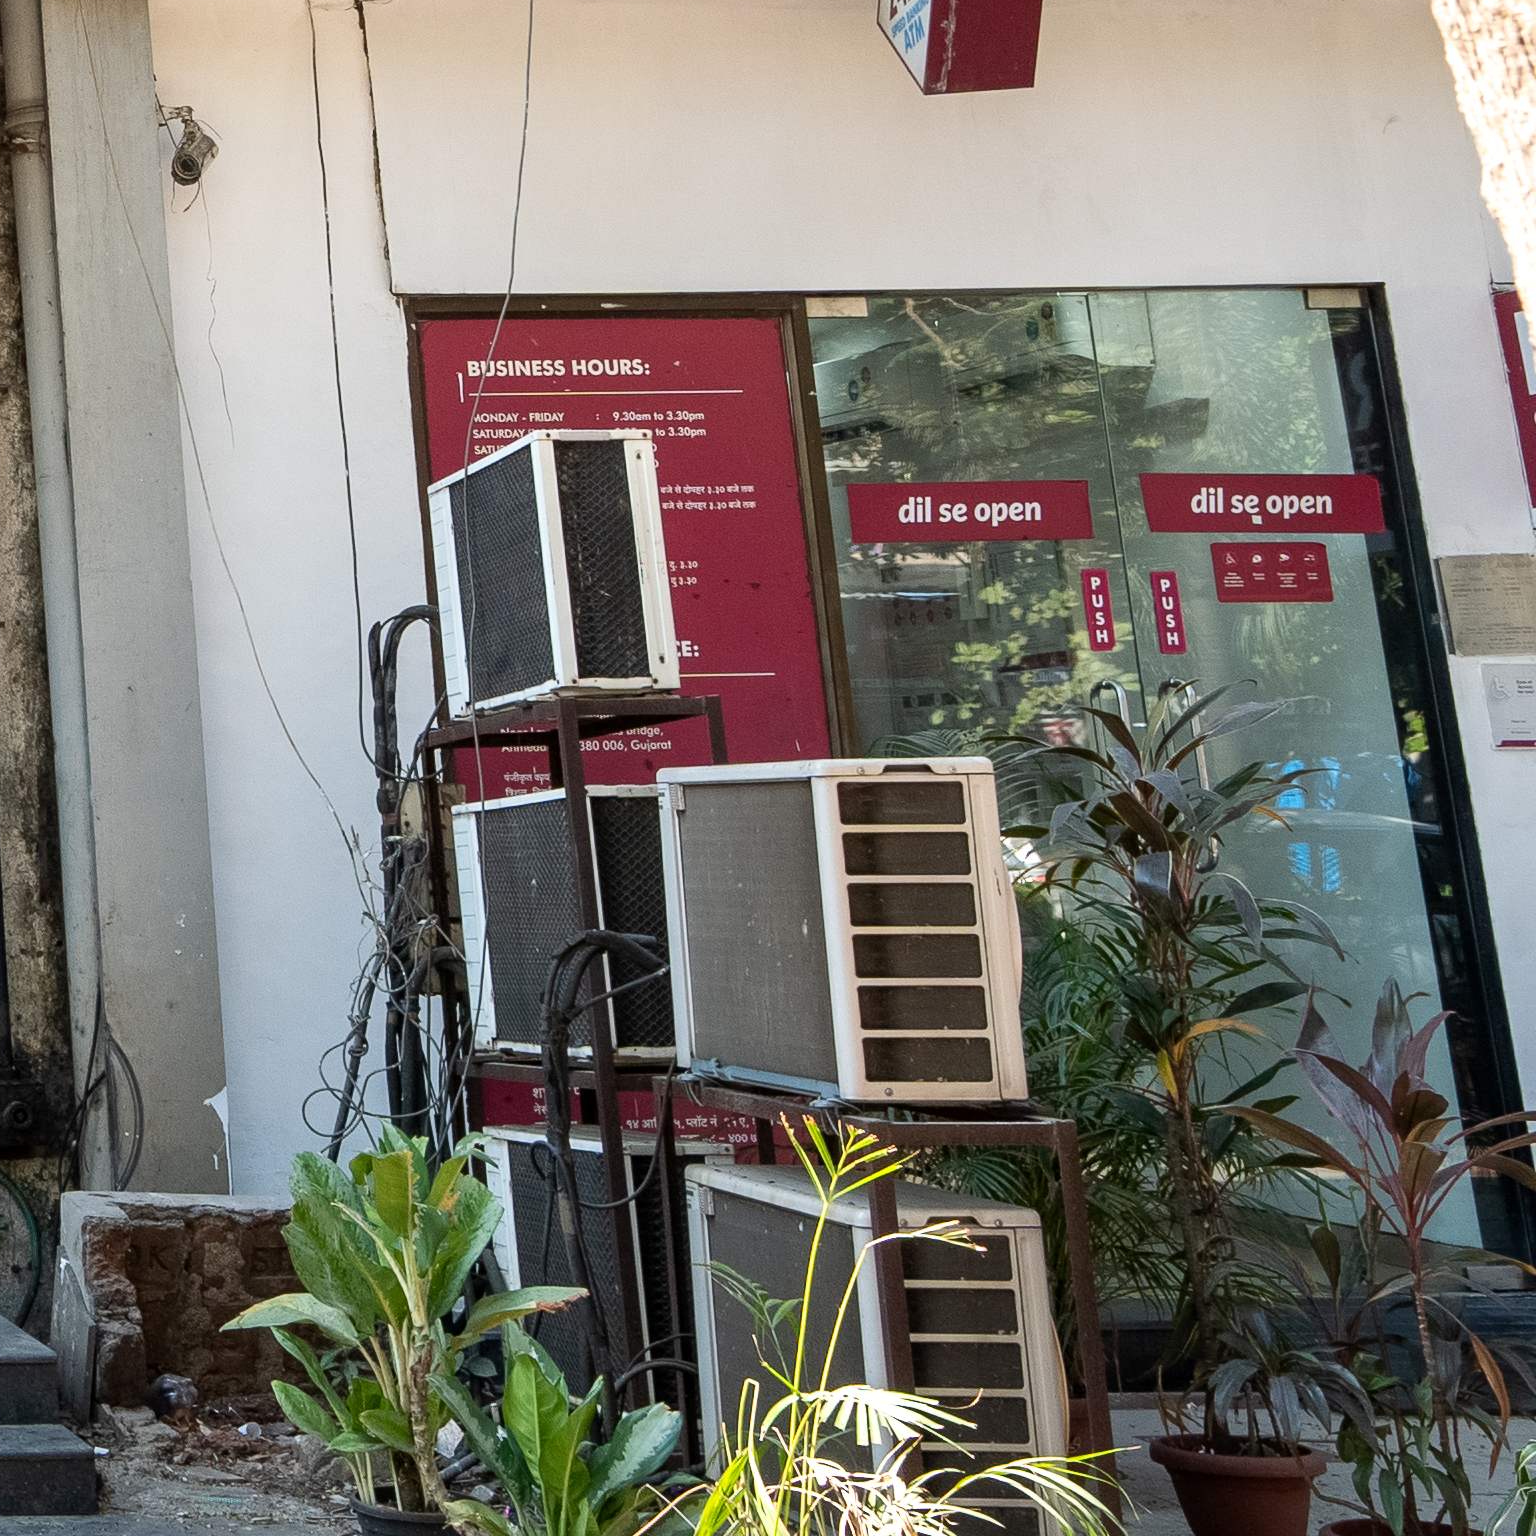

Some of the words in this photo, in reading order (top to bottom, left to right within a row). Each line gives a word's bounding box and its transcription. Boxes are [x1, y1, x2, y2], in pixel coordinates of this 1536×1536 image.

[904, 16, 925, 54] ATM
[467, 360, 565, 377] BUSINESS
[572, 359, 650, 376] HOURS:
[529, 412, 564, 422] FRIDAY
[613, 412, 651, 421] 9.30am
[654, 412, 664, 421] to
[666, 411, 705, 423] 3.30pm
[656, 428, 666, 437] to
[668, 428, 706, 439] 3.30pm
[898, 498, 932, 524] dil
[939, 504, 968, 523] se
[974, 498, 1041, 527] open
[1191, 488, 1225, 515] dil
[1231, 494, 1260, 514] se
[1266, 490, 1332, 521] open
[1089, 576, 1109, 643] PUSH
[1160, 579, 1180, 646] PUSH
[579, 740, 599, 751] 380
[603, 740, 628, 751] 006,
[631, 739, 672, 752] Gujarat
